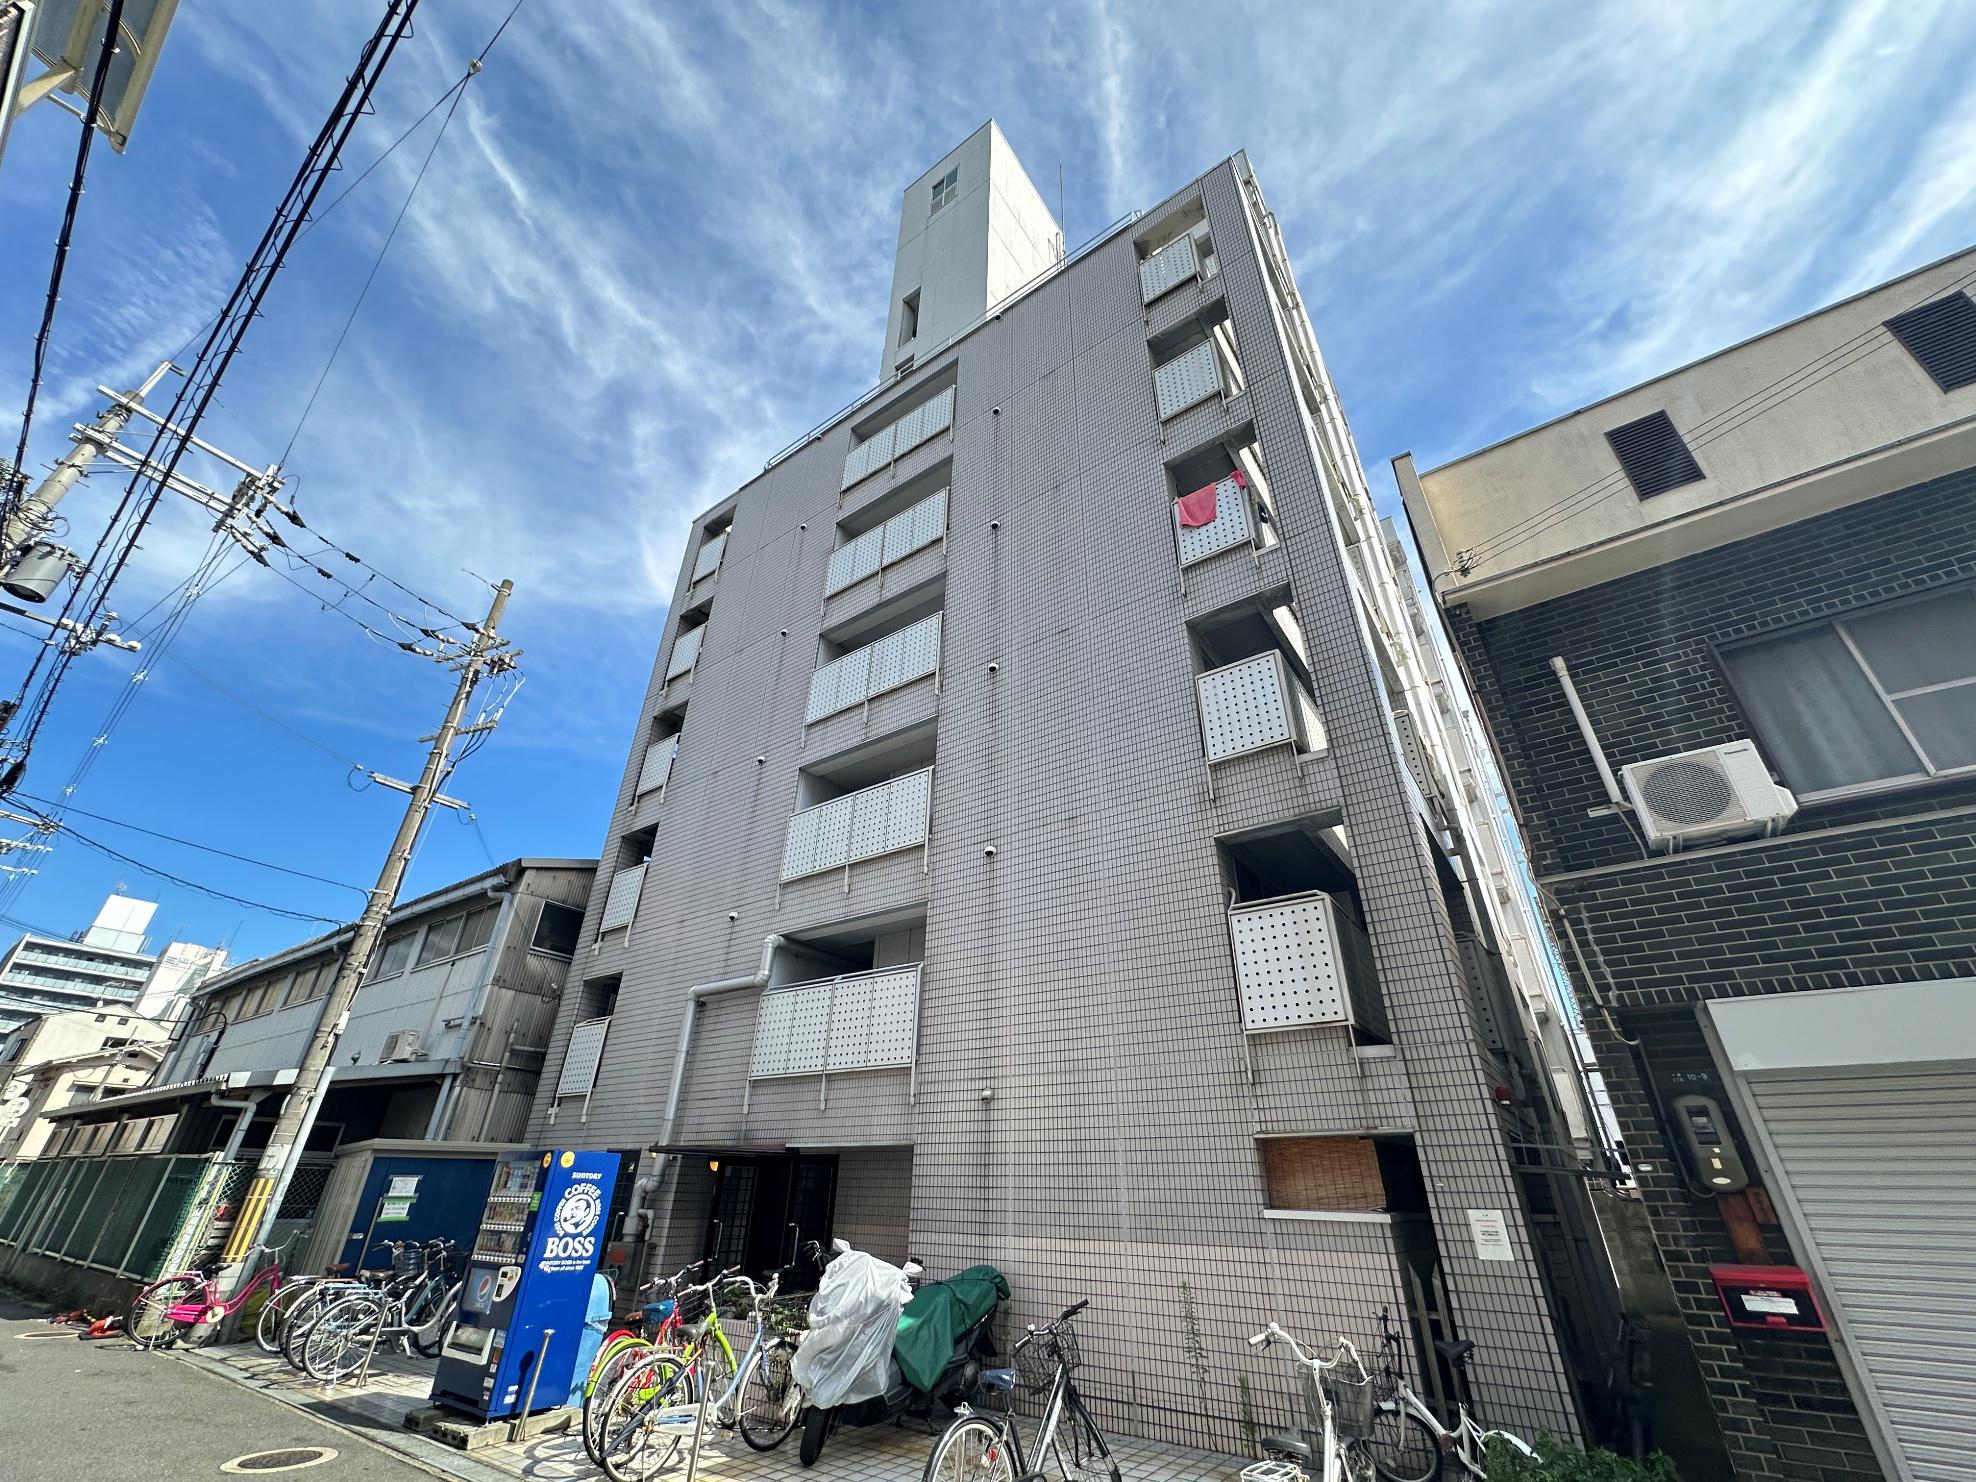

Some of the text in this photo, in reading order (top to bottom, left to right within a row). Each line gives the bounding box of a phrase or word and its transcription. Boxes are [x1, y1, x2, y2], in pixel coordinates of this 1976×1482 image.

[1686, 1072, 1707, 1081] 10-9
[571, 1172, 602, 1180] SUNTORY
[564, 1183, 602, 1200] COFFEE
[543, 1236, 596, 1258] BOSS
